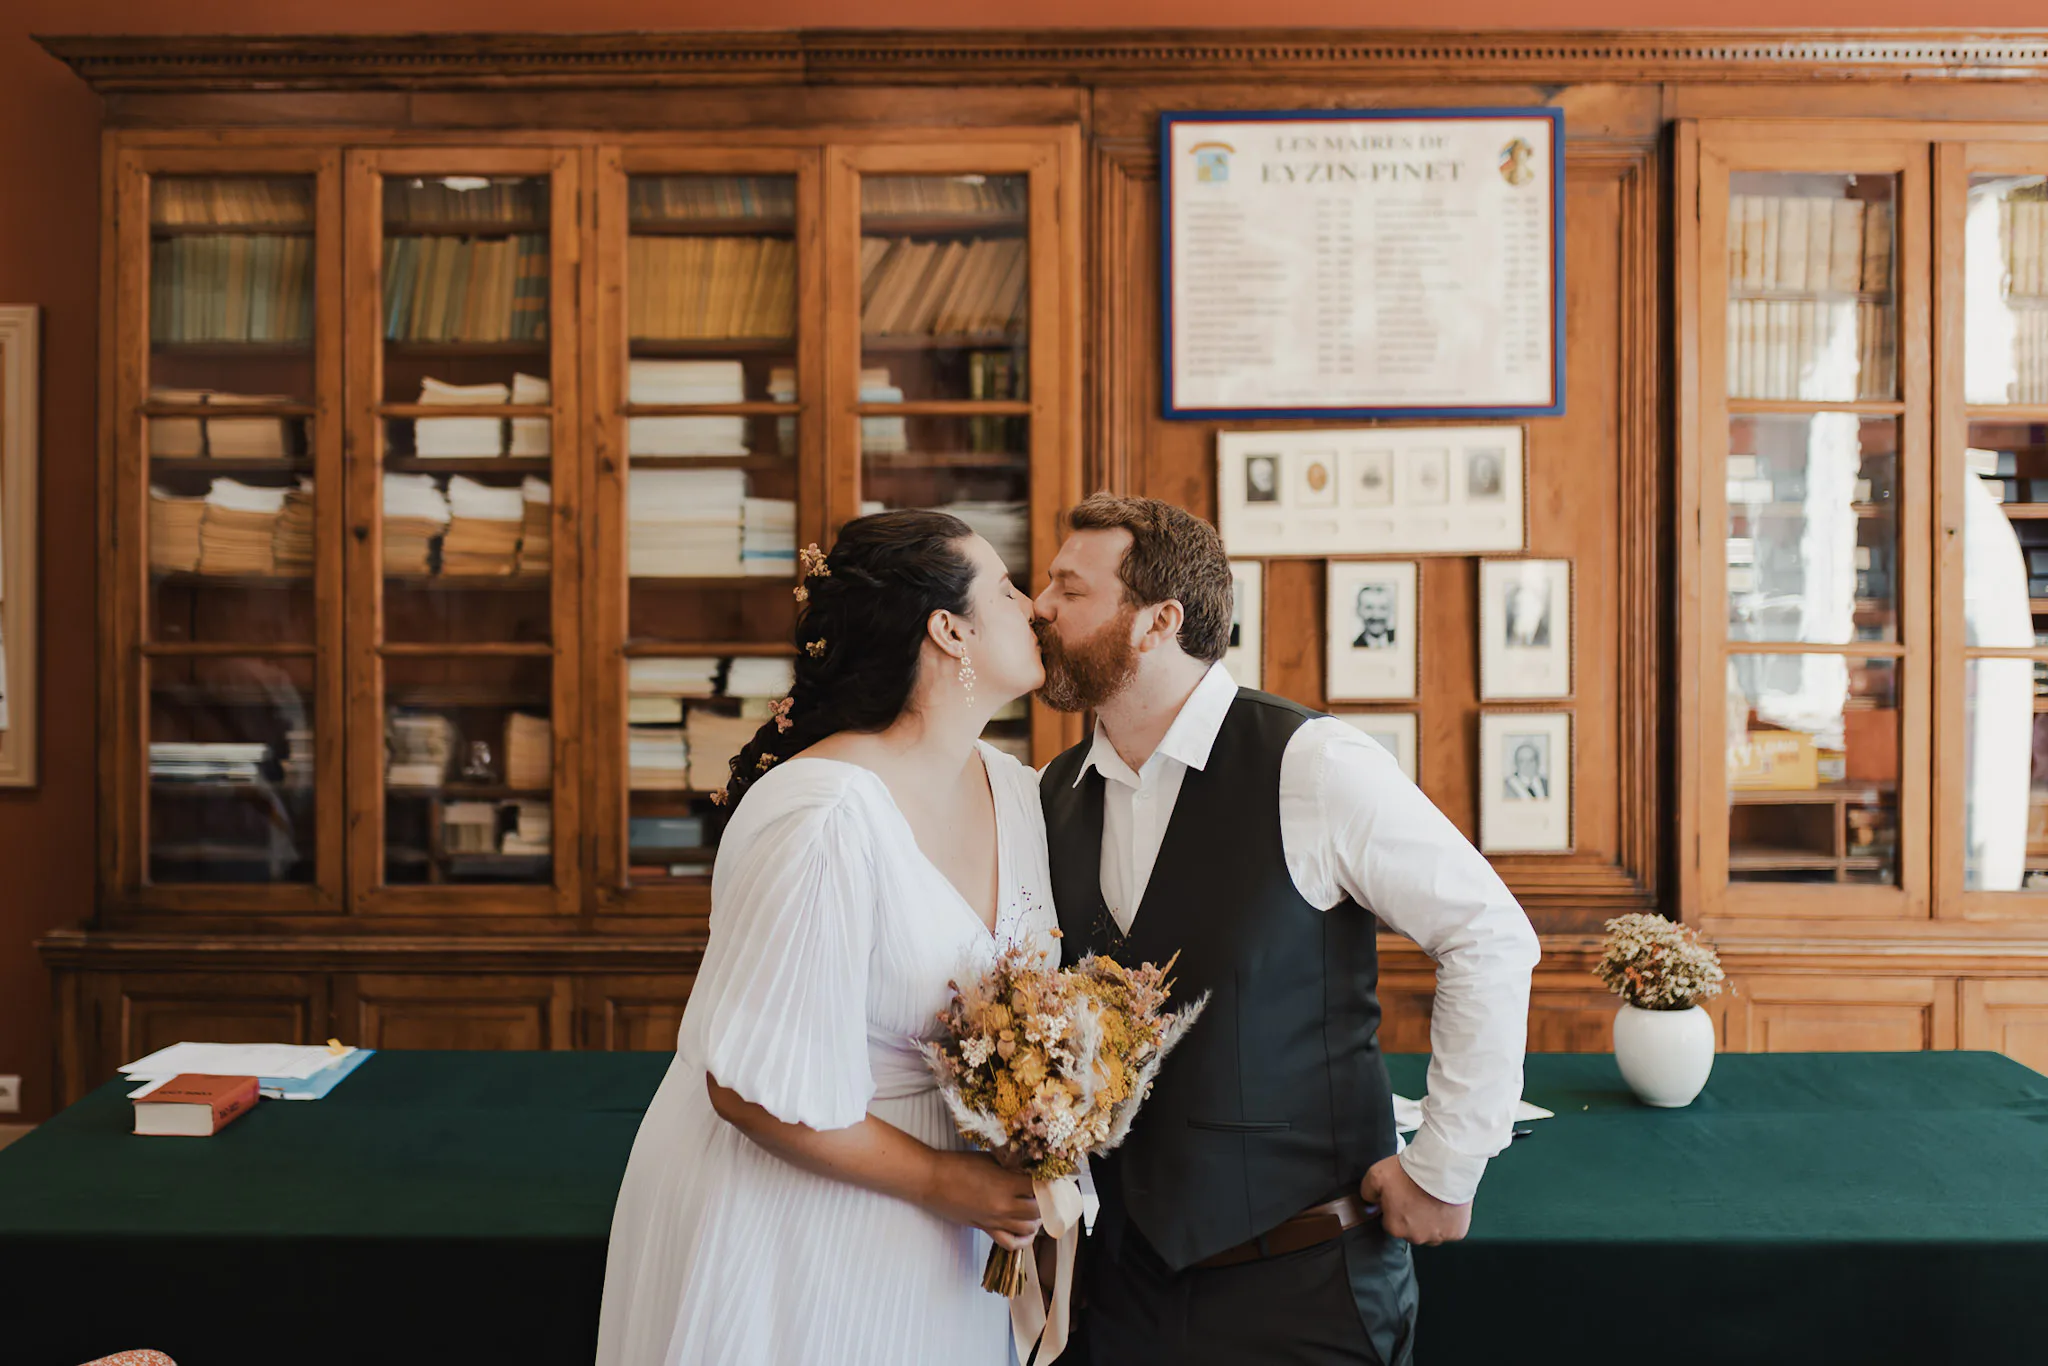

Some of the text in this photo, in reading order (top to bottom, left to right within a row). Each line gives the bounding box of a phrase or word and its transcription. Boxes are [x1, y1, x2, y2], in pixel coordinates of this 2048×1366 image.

[1276, 136, 1317, 152] LES
[1323, 135, 1412, 151] MAIRES
[1261, 161, 1466, 184] EYZIN-PINET
